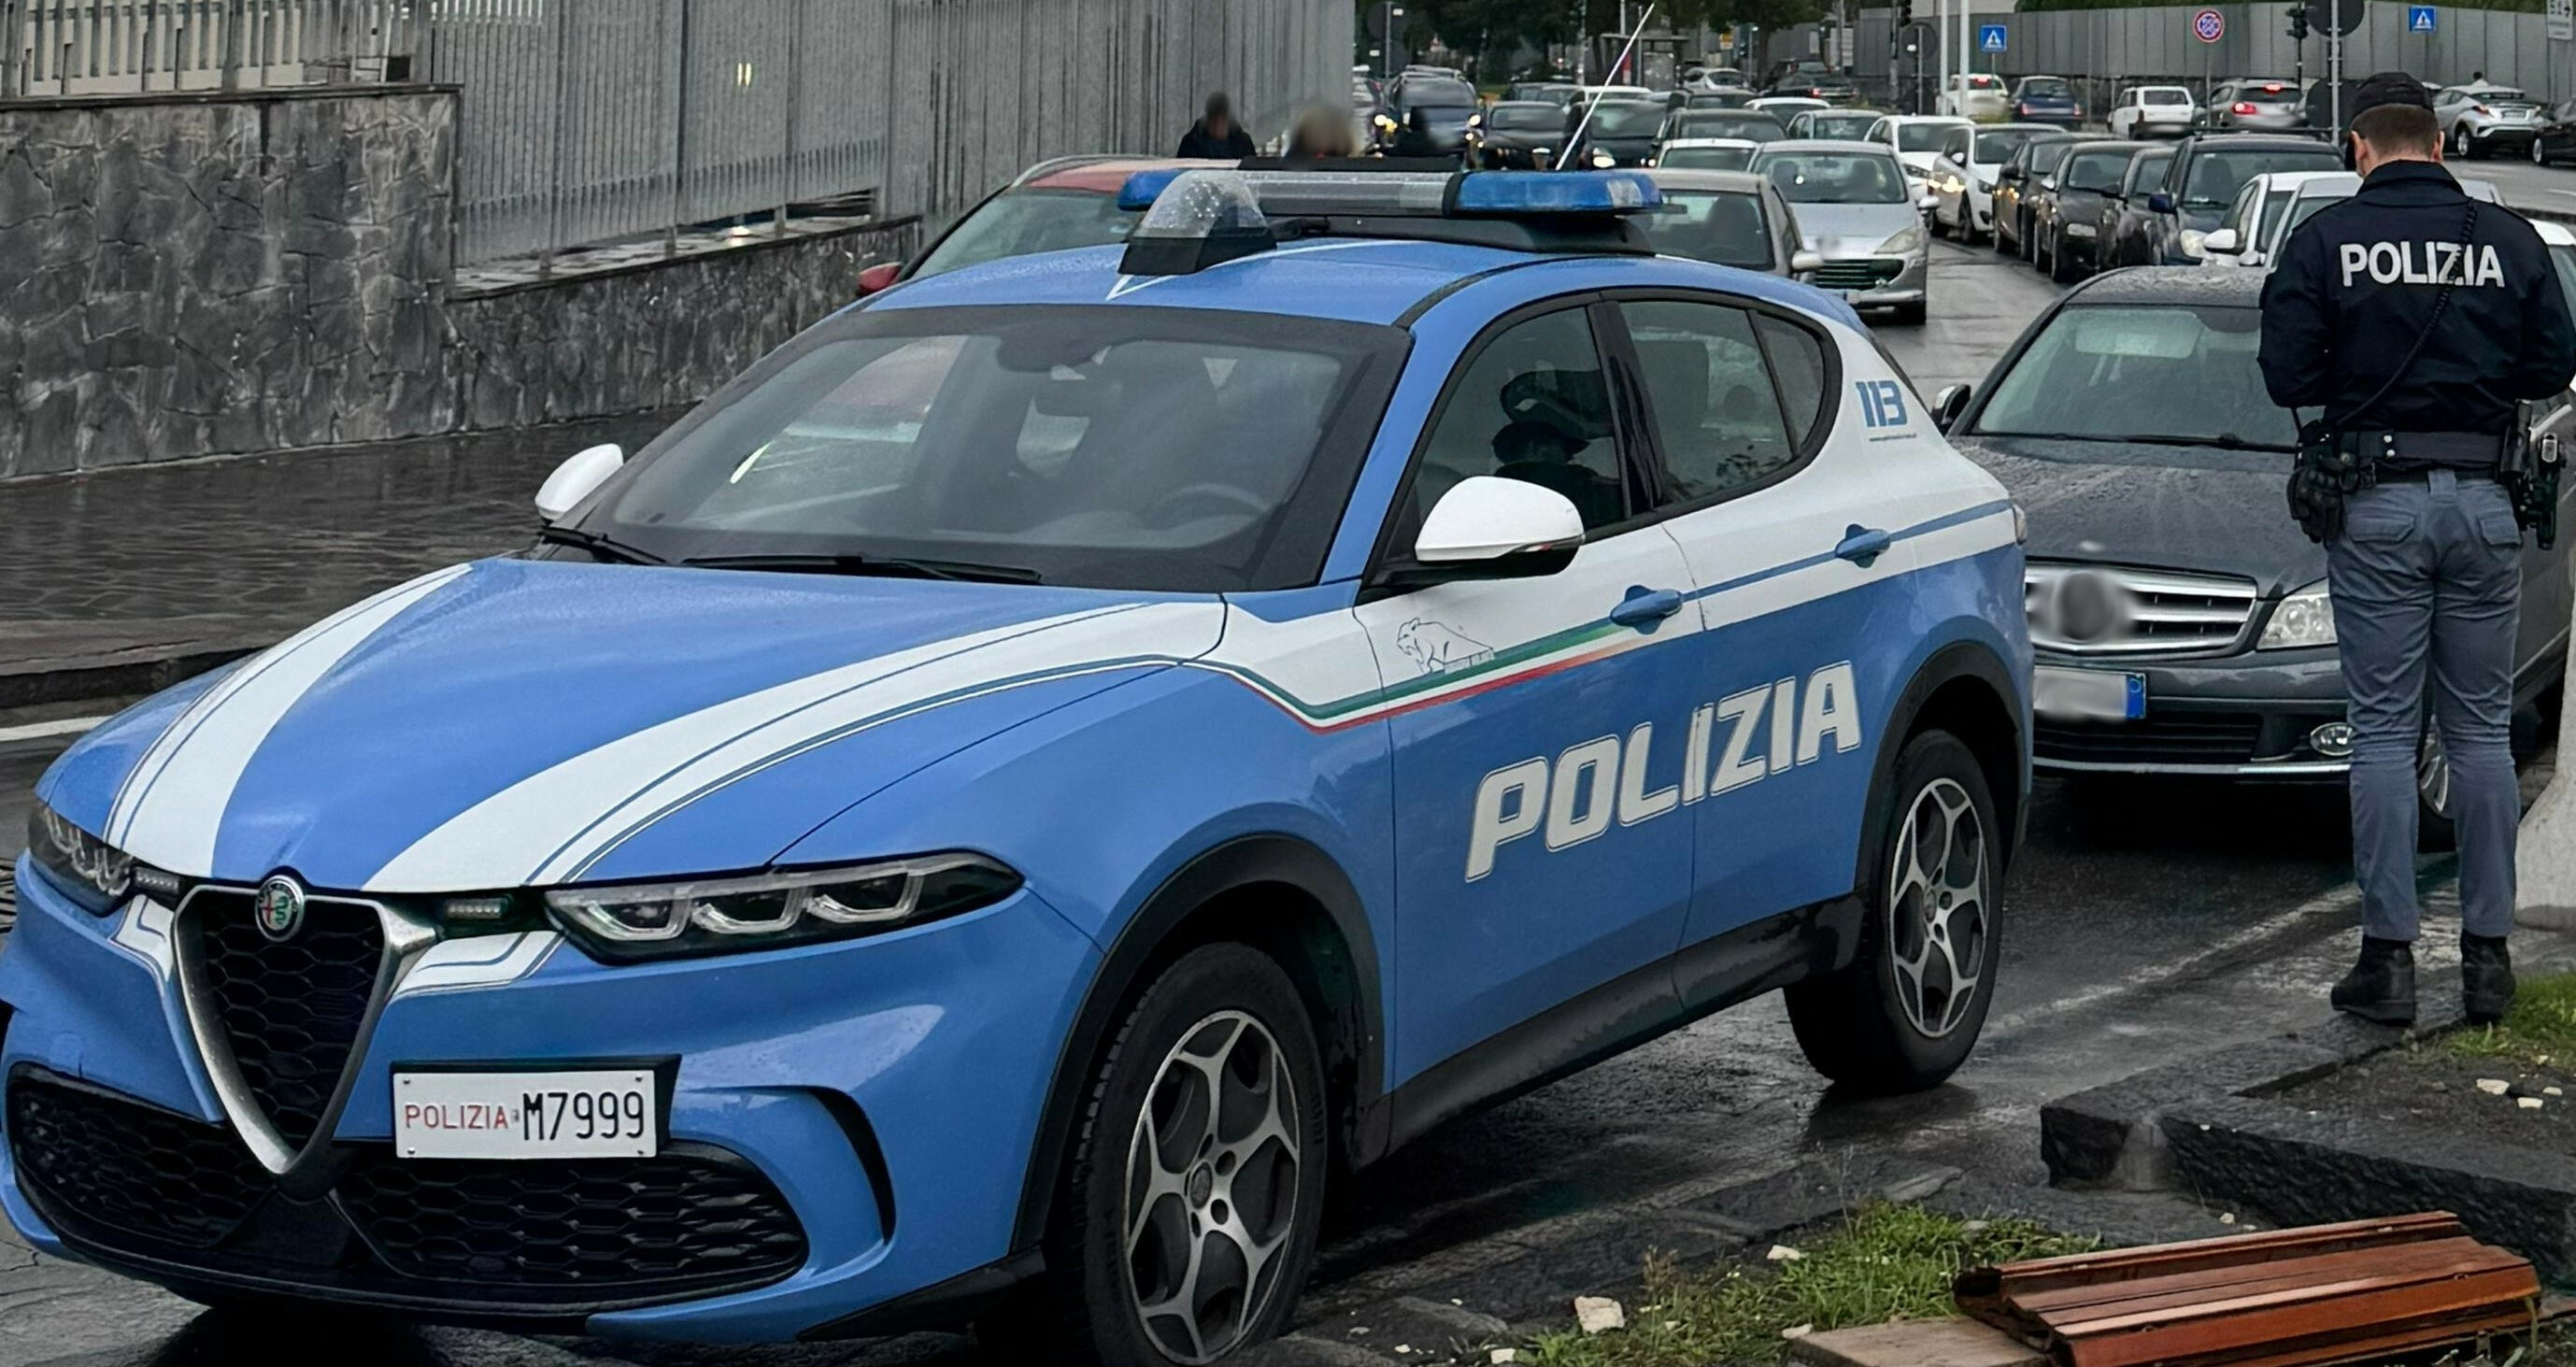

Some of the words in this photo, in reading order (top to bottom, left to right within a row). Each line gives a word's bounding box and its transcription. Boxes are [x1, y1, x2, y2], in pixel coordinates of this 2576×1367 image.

[2340, 241, 2505, 288] POLIZIA
[1855, 380, 1908, 427] 113
[1464, 660, 1862, 883] POLIZIA
[404, 1104, 509, 1130] POLIZIA
[522, 1090, 645, 1141] M7999
